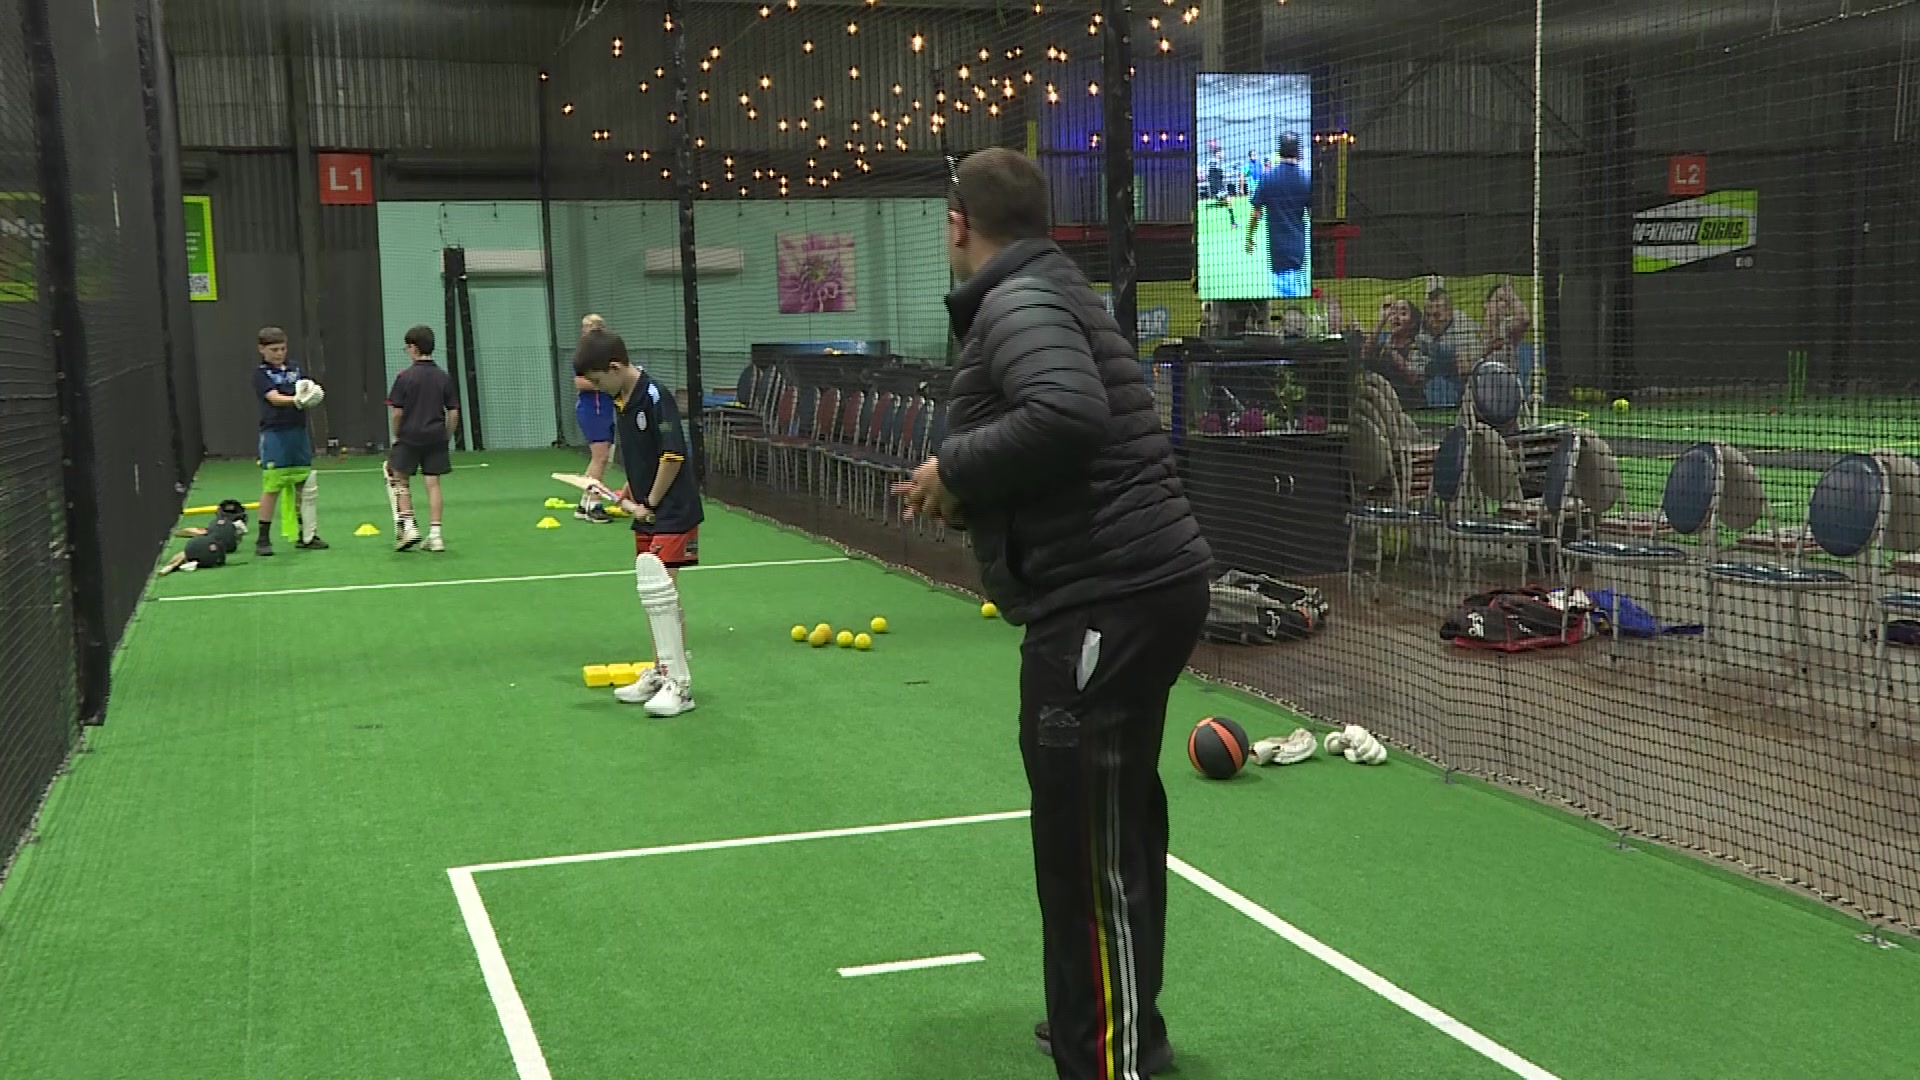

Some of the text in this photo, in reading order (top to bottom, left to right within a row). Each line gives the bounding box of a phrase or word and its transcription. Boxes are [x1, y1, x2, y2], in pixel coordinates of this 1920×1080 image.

[329, 166, 363, 191] L1
[1675, 164, 1700, 185] L2
[1701, 221, 1744, 240] SIGNS
